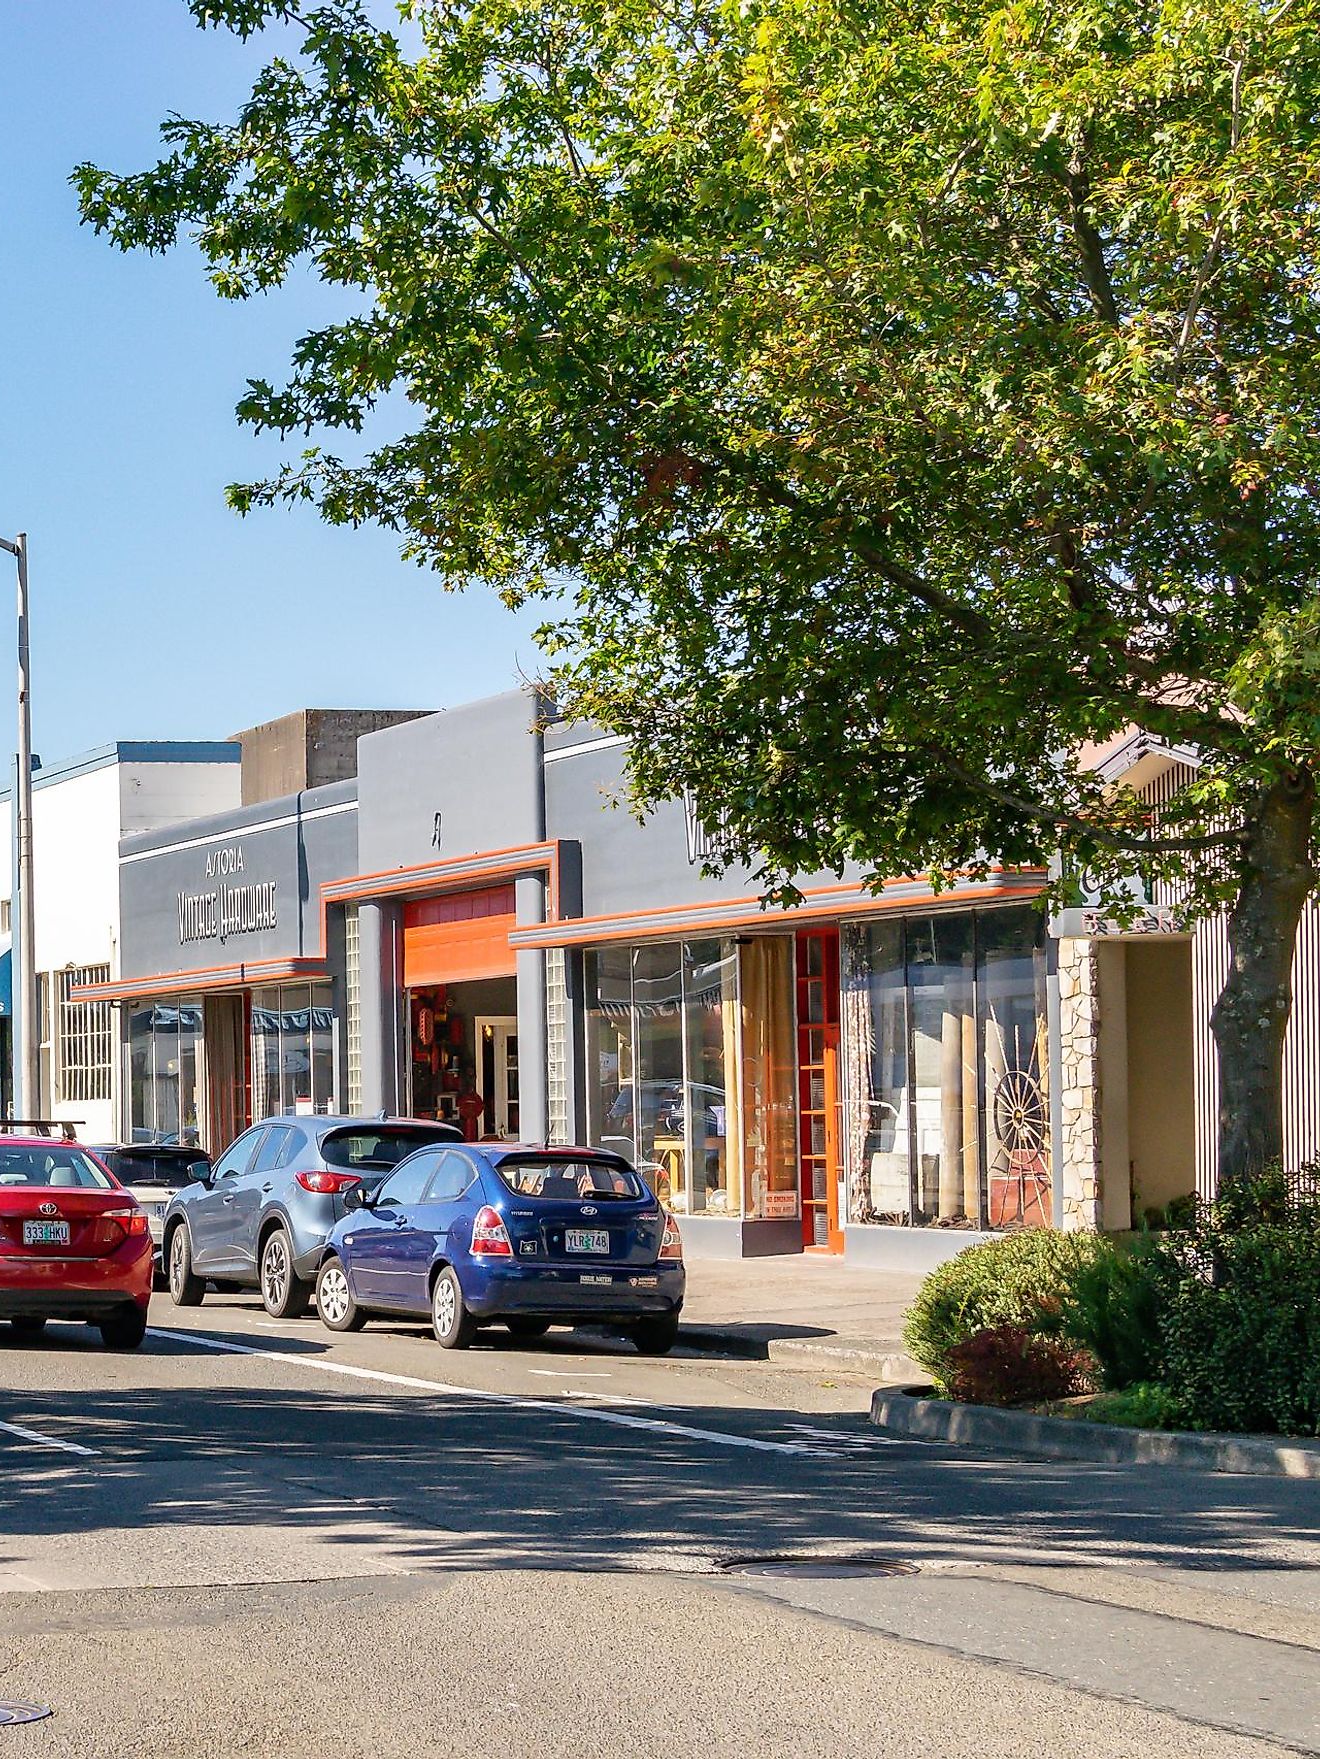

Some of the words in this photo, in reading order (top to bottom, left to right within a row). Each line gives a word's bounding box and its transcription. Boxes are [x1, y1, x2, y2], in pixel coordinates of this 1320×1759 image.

[205, 845, 244, 879] ASTORIA
[25, 1226, 44, 1239] 333
[49, 1226, 68, 1239] HKU
[567, 1235, 585, 1247] YLR
[590, 1236, 607, 1248] 748
